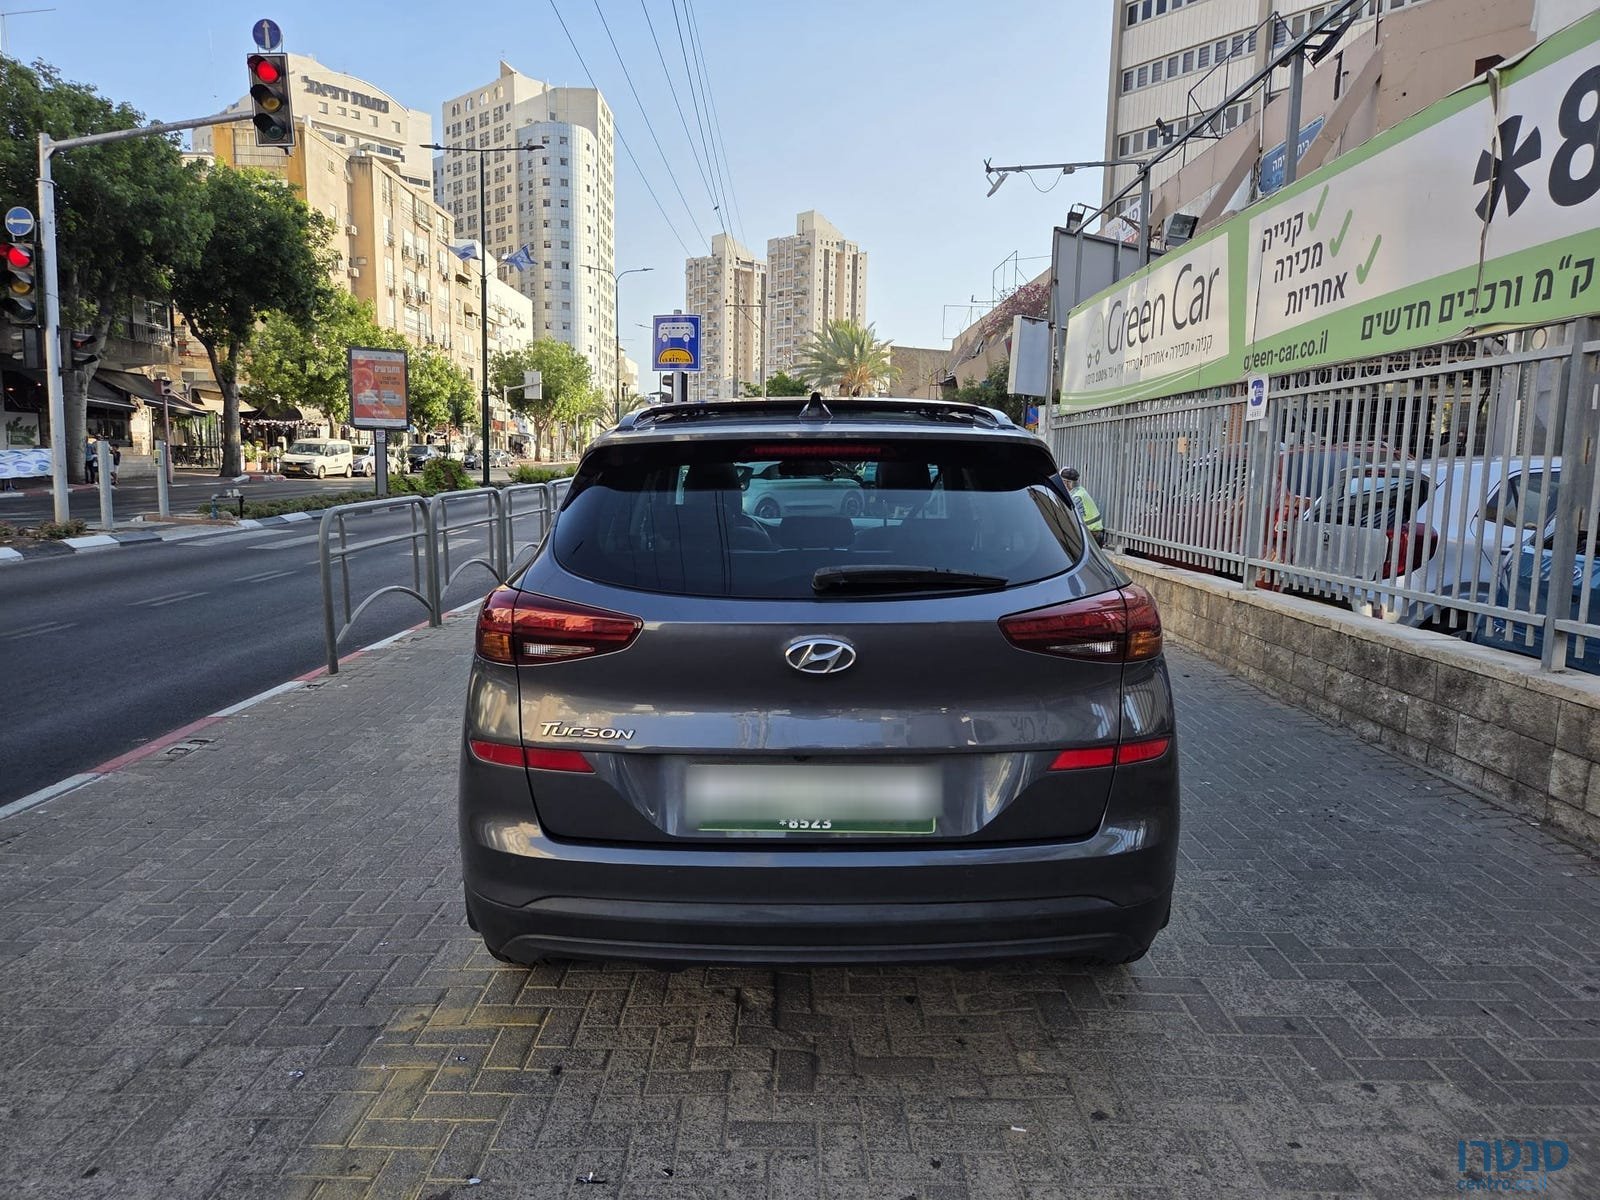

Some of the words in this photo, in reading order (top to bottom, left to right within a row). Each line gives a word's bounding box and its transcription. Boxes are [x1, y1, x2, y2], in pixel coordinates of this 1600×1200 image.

[1261, 211, 1304, 253] קנייה
[1274, 241, 1323, 284] מכירה
[1107, 293, 1166, 355] Green
[1172, 263, 1220, 330] Car
[1284, 271, 1348, 317] אחריות
[1438, 275, 1524, 324] ורכבים
[1361, 300, 1431, 341] חדשים
[1143, 351, 1166, 368] אחריות
[1169, 341, 1190, 361] מכירה
[1194, 334, 1213, 356] קניה
